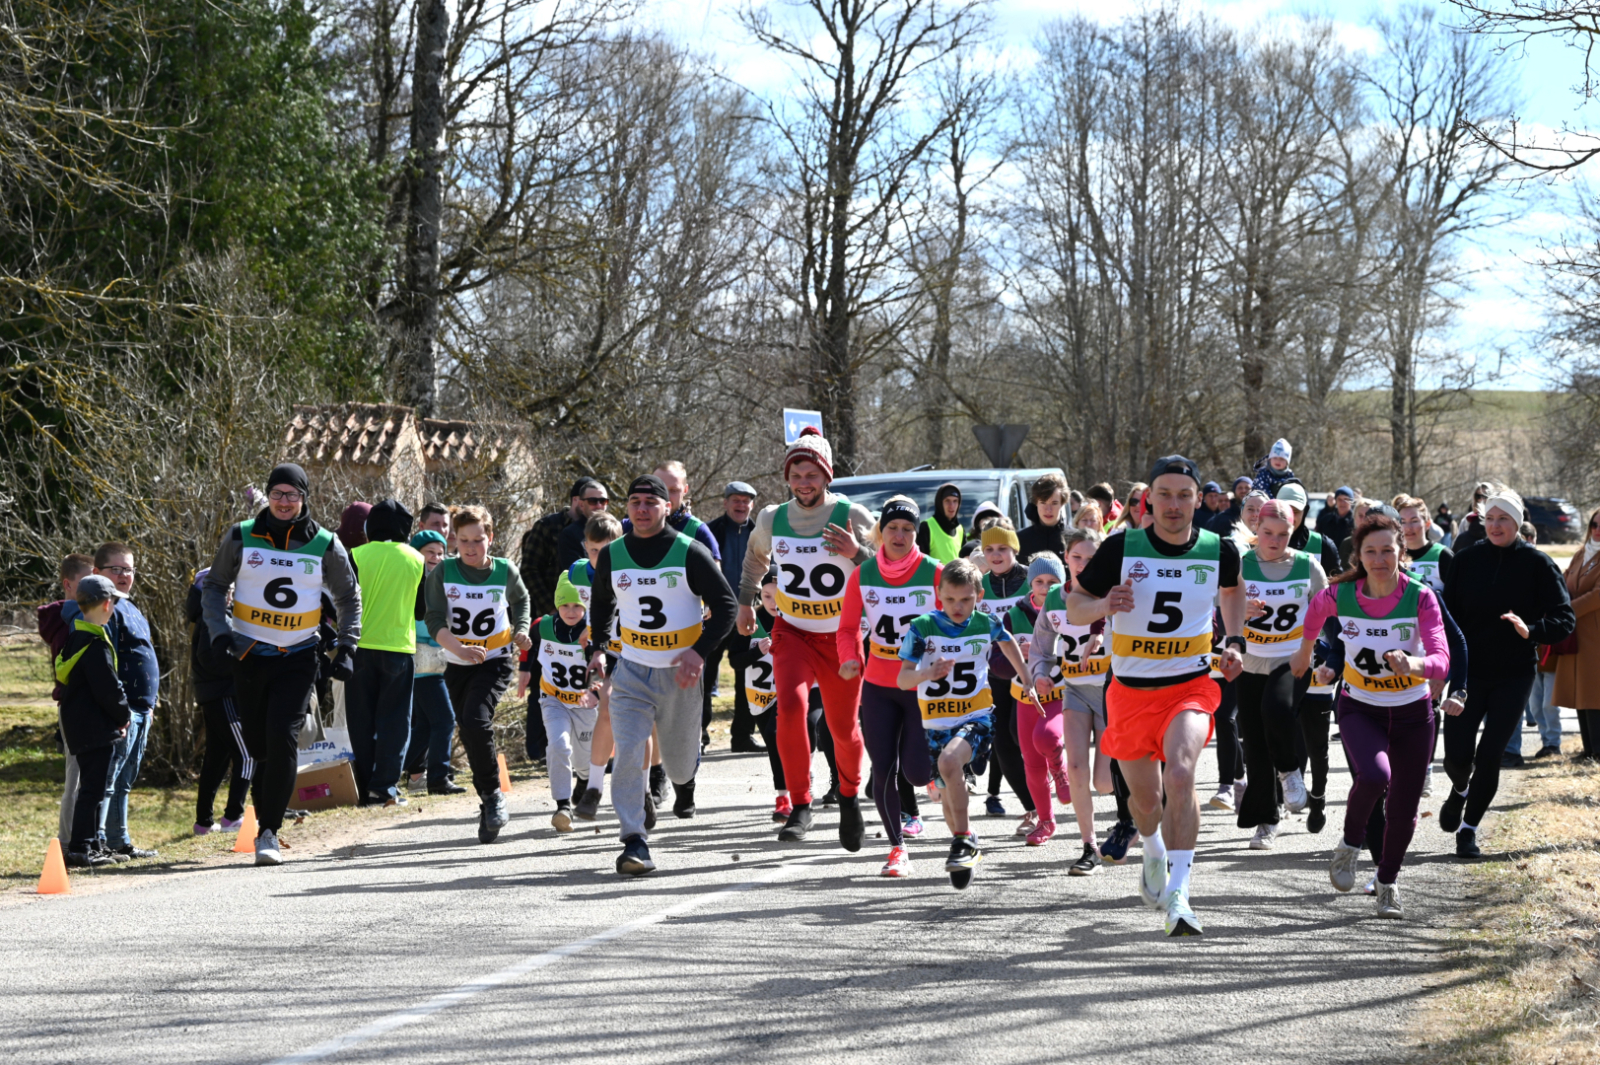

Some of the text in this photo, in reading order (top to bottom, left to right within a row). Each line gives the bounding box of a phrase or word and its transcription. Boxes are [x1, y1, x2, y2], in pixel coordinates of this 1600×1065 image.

[263, 577, 298, 609] 6
[780, 563, 845, 598] 20
[251, 609, 302, 629] PREIĻI
[450, 607, 496, 637] 36
[638, 595, 667, 630] 3
[1147, 591, 1183, 633] 5
[1247, 603, 1300, 632] 28
[631, 633, 678, 648] PREIĻI
[551, 662, 587, 690] 38
[752, 661, 775, 690] 2
[925, 661, 977, 697] 35
[300, 742, 336, 751] UPPA
